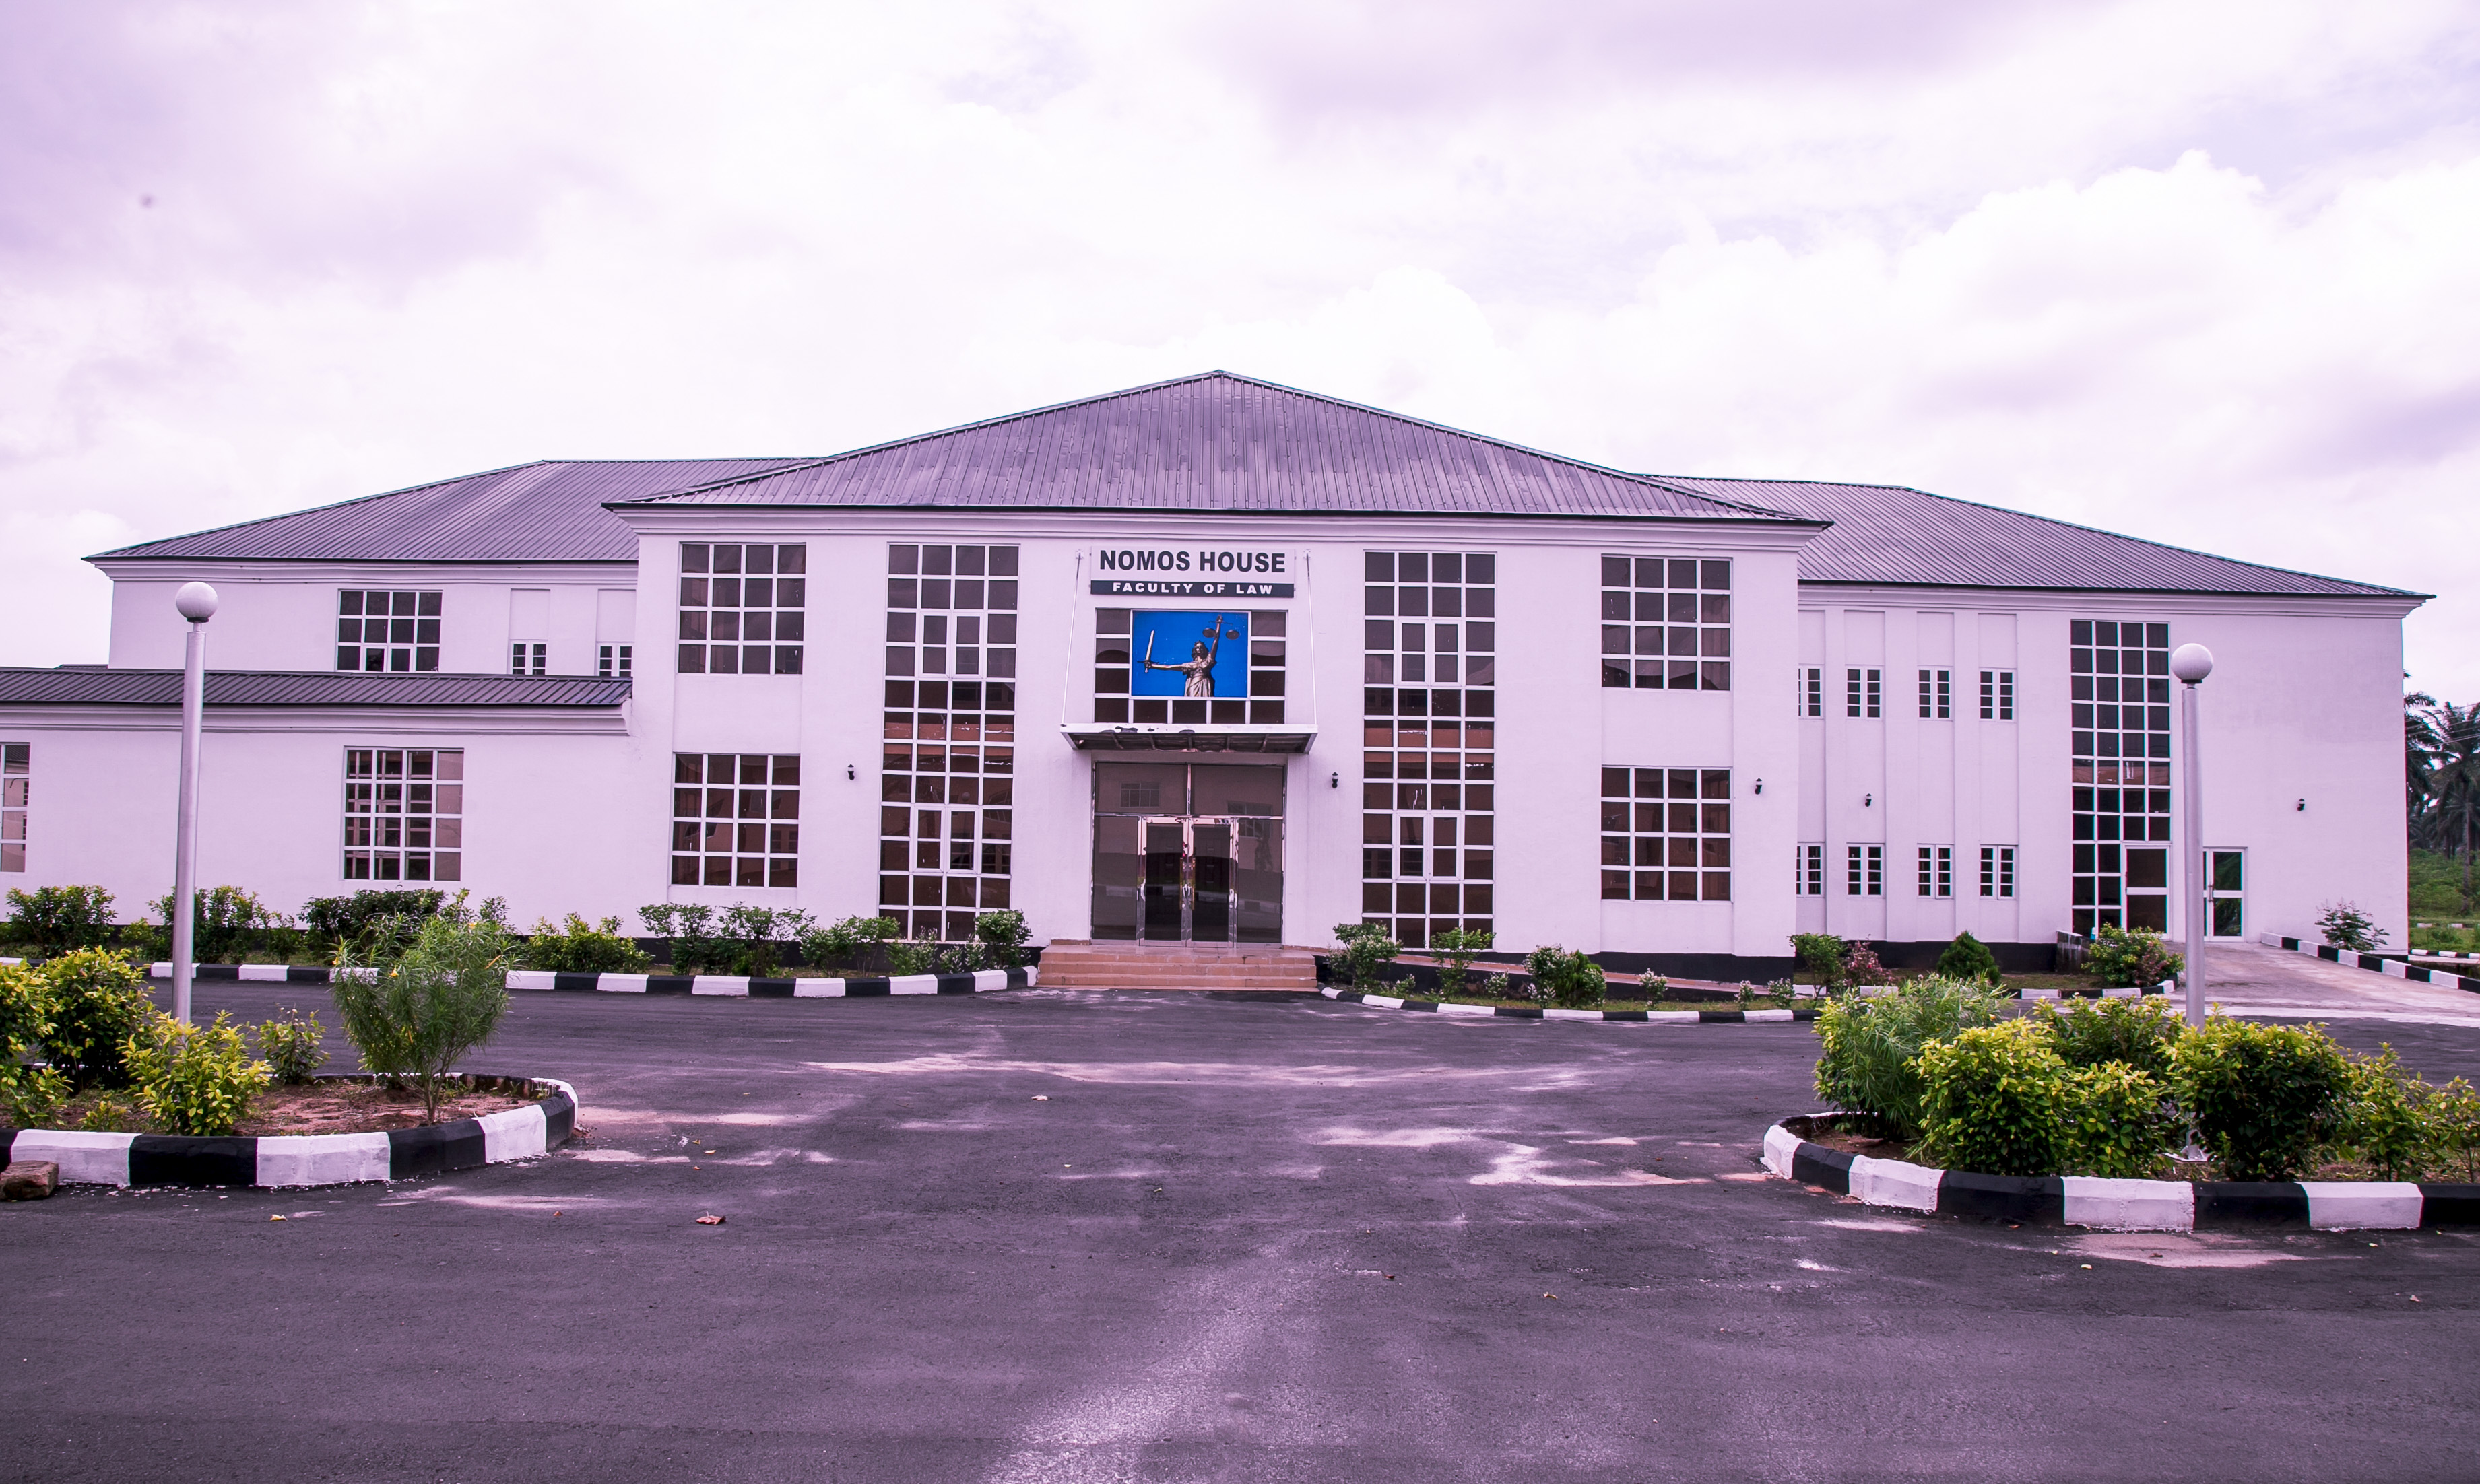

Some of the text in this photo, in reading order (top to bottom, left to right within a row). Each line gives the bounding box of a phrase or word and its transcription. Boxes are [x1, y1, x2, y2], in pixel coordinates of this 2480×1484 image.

[1099, 549, 1286, 573] NOMOS HOUSE
[1113, 582, 1273, 595] FACULTY OF LAW
